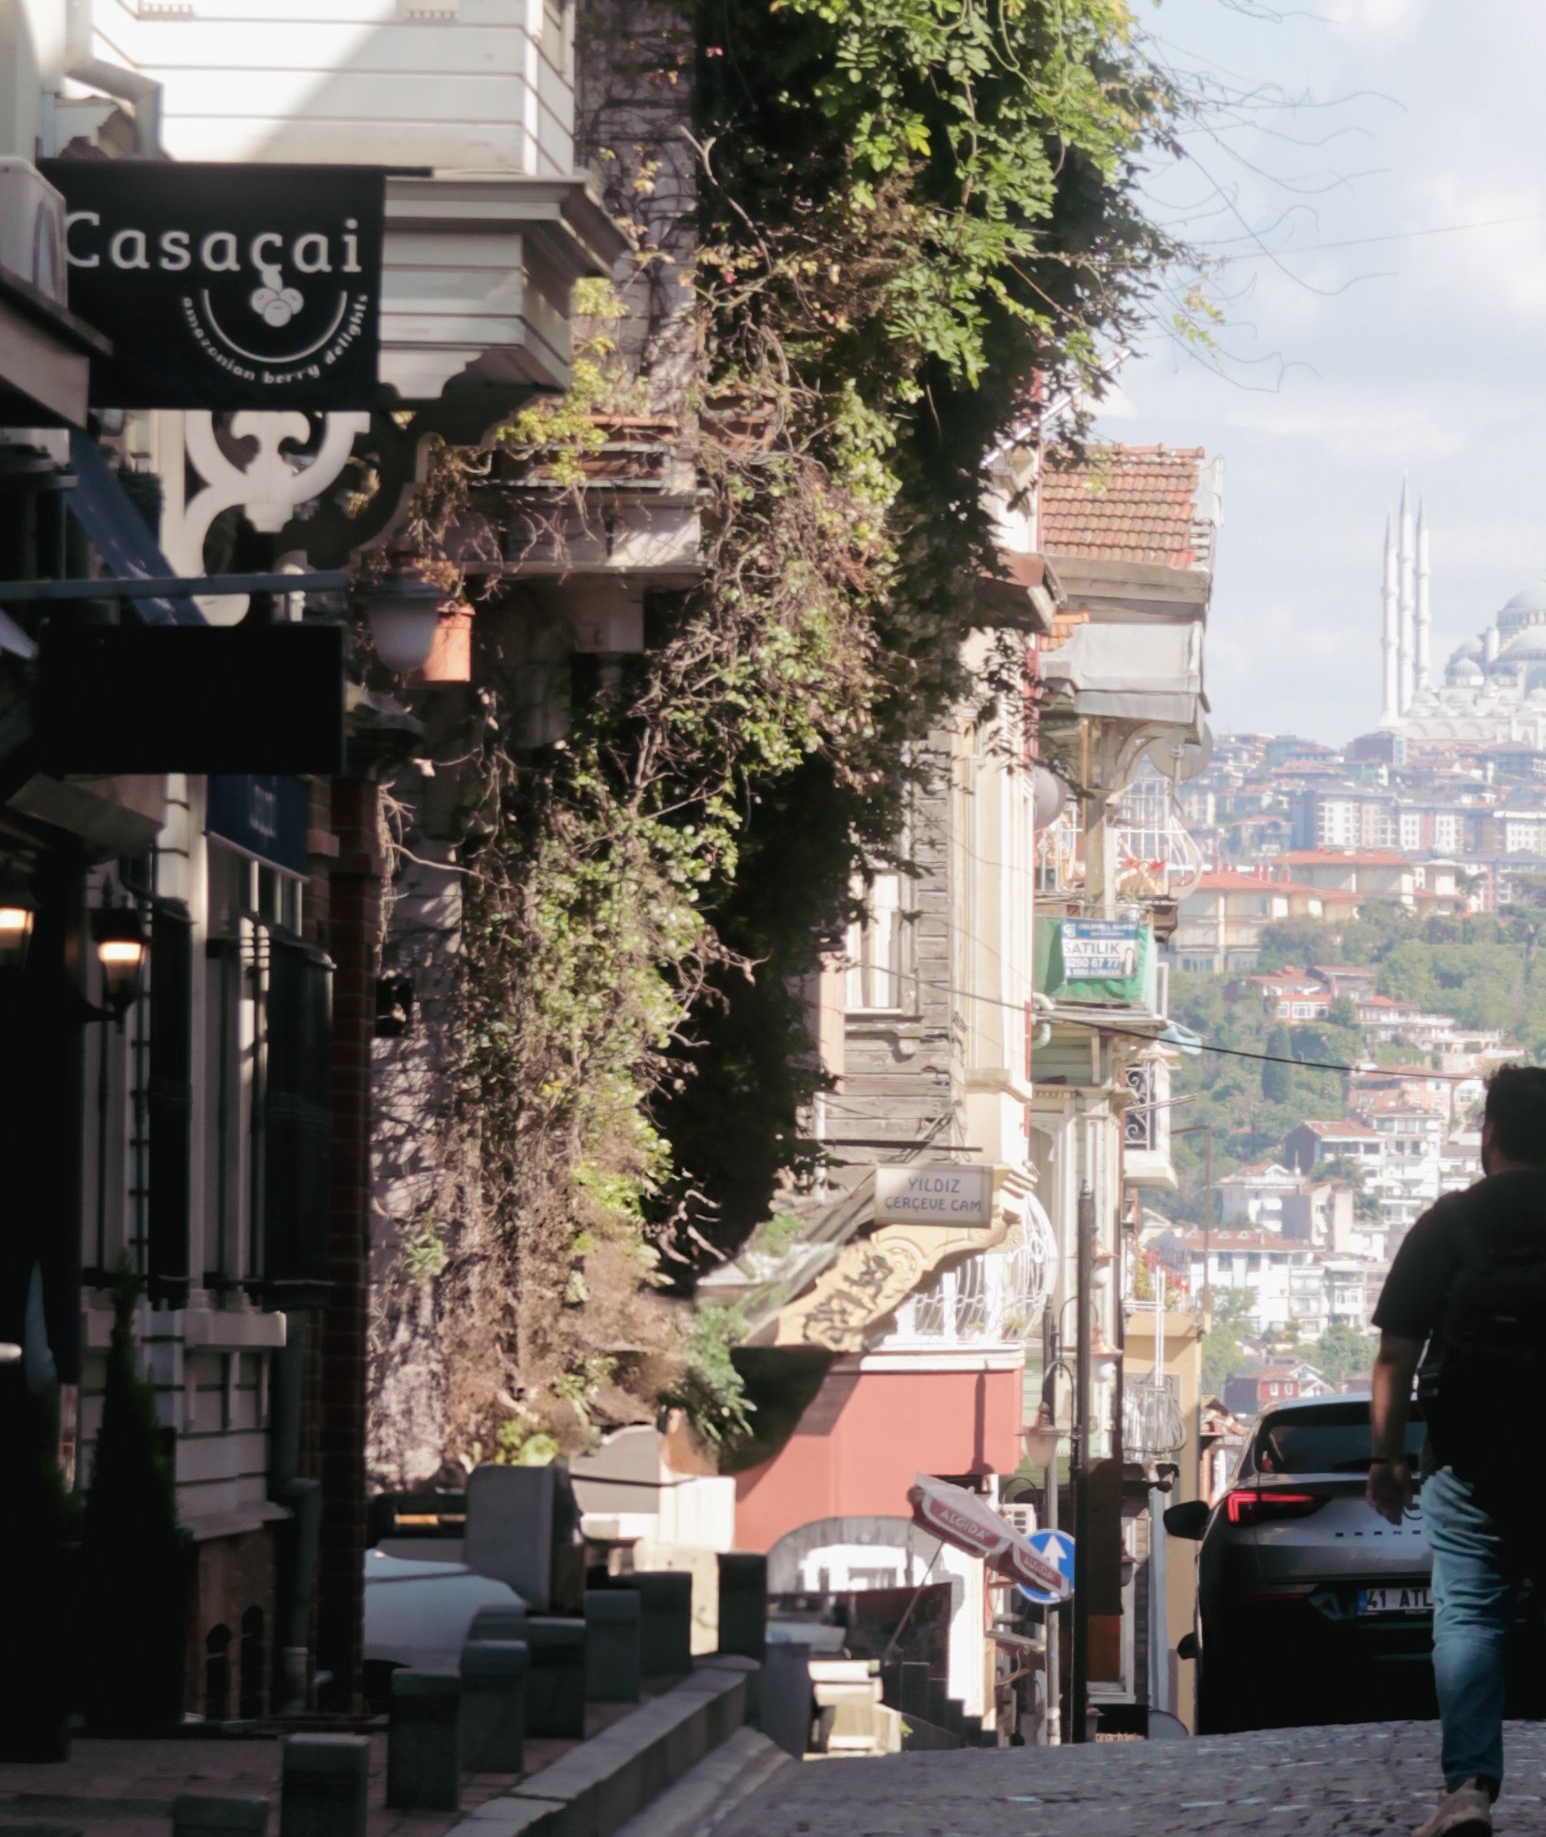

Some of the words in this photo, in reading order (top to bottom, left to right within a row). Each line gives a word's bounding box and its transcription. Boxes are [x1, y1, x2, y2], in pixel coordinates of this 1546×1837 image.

[64, 211, 363, 274] Casaçai
[181, 297, 256, 381] amazonian
[262, 364, 320, 385] berry
[325, 294, 369, 365] delights
[1064, 942, 1120, 954] SATILIK
[908, 1177, 961, 1193] YILDIZ
[950, 1199, 982, 1212] CAM
[1367, 1590, 1386, 1608] 41
